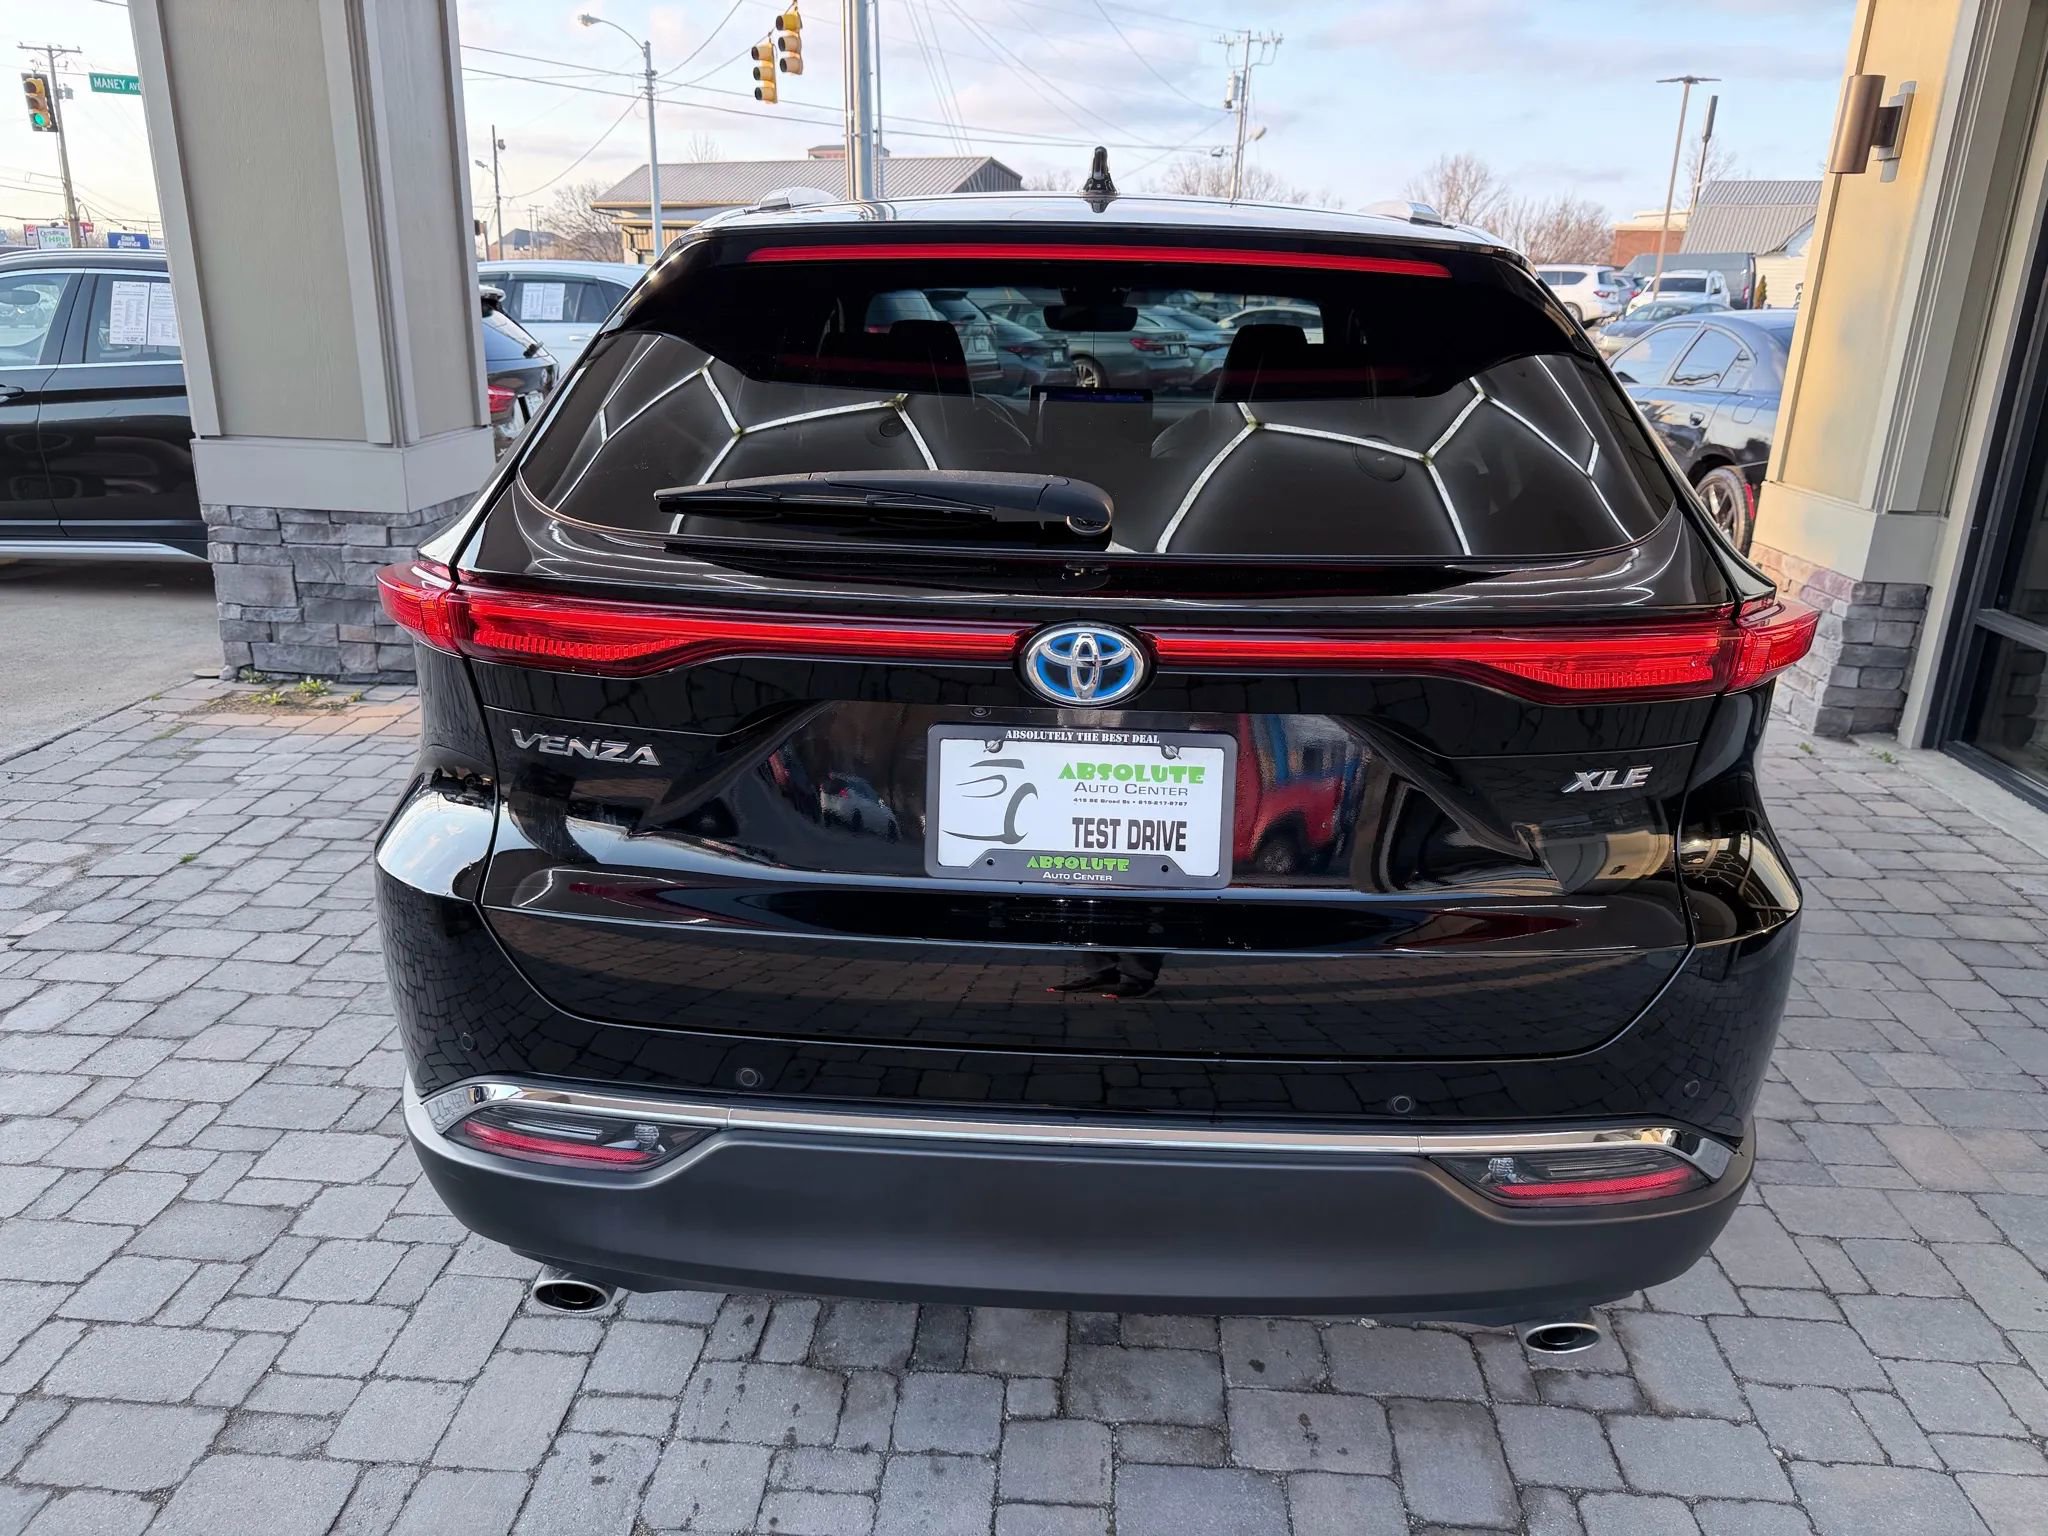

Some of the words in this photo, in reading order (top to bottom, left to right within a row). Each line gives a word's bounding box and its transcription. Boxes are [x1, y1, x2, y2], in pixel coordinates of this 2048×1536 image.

[93, 77, 125, 90] MANEY
[511, 728, 661, 766] VENZA
[1005, 730, 1074, 741] ABSOLUTELY
[1077, 732, 1099, 742] THE
[1101, 733, 1130, 743] BEST
[1132, 734, 1160, 744] DEAL
[1058, 762, 1206, 784] ABSOLUTE
[1561, 765, 1654, 793] XLE
[1071, 817, 1121, 850] TEST
[1127, 819, 1187, 852] DRIVE
[1026, 855, 1130, 872] ABSOLUTE
